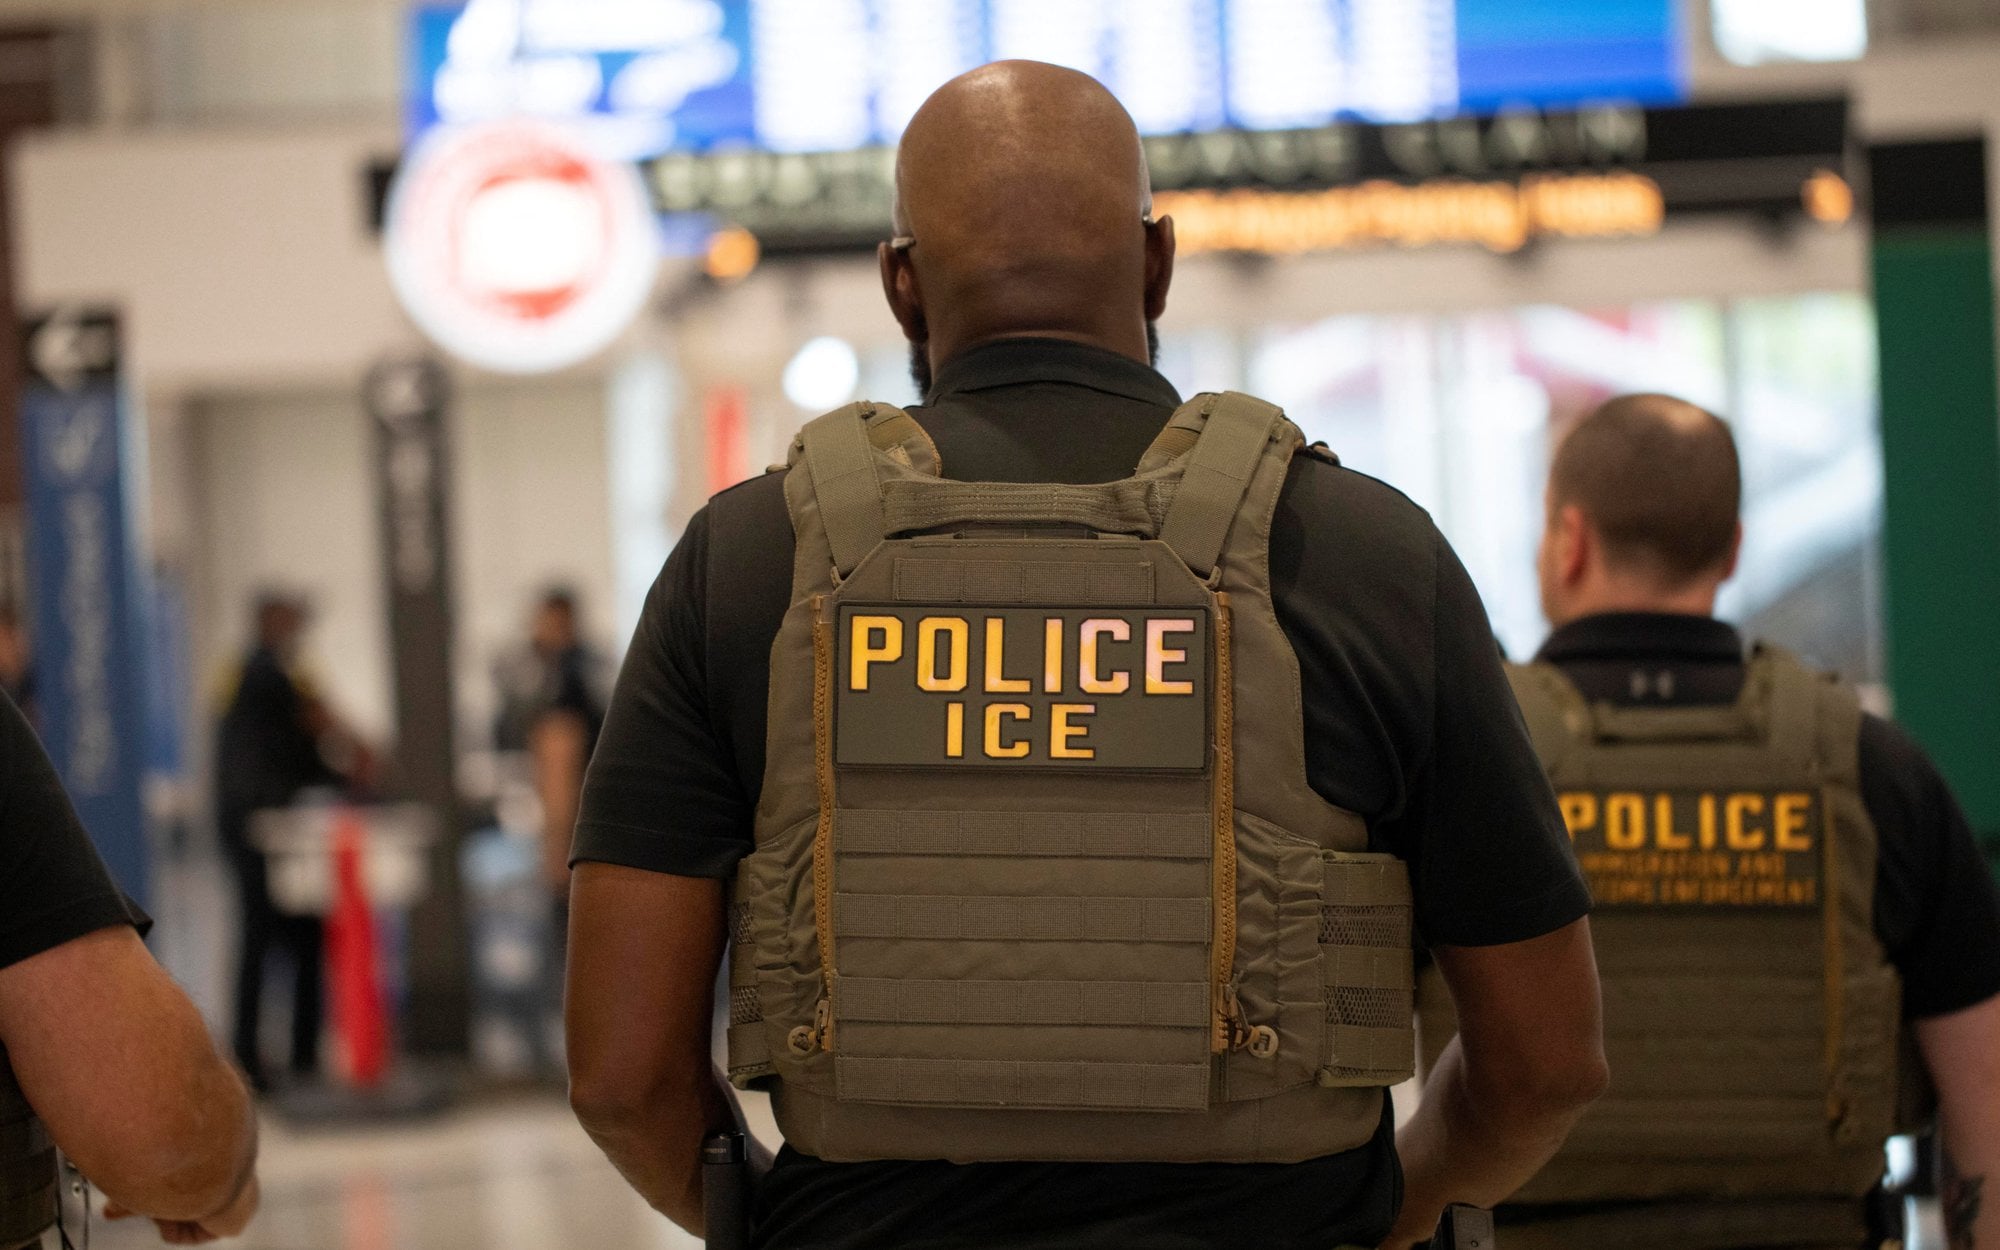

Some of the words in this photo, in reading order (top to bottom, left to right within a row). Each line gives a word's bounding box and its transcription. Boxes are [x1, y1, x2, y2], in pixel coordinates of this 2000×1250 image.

[849, 614, 1195, 695] POLICE
[945, 702, 1096, 759] ICE
[1557, 793, 1812, 850] POLICE
[1578, 853, 1729, 876] MMIGRATION
[1737, 853, 1786, 875] AND
